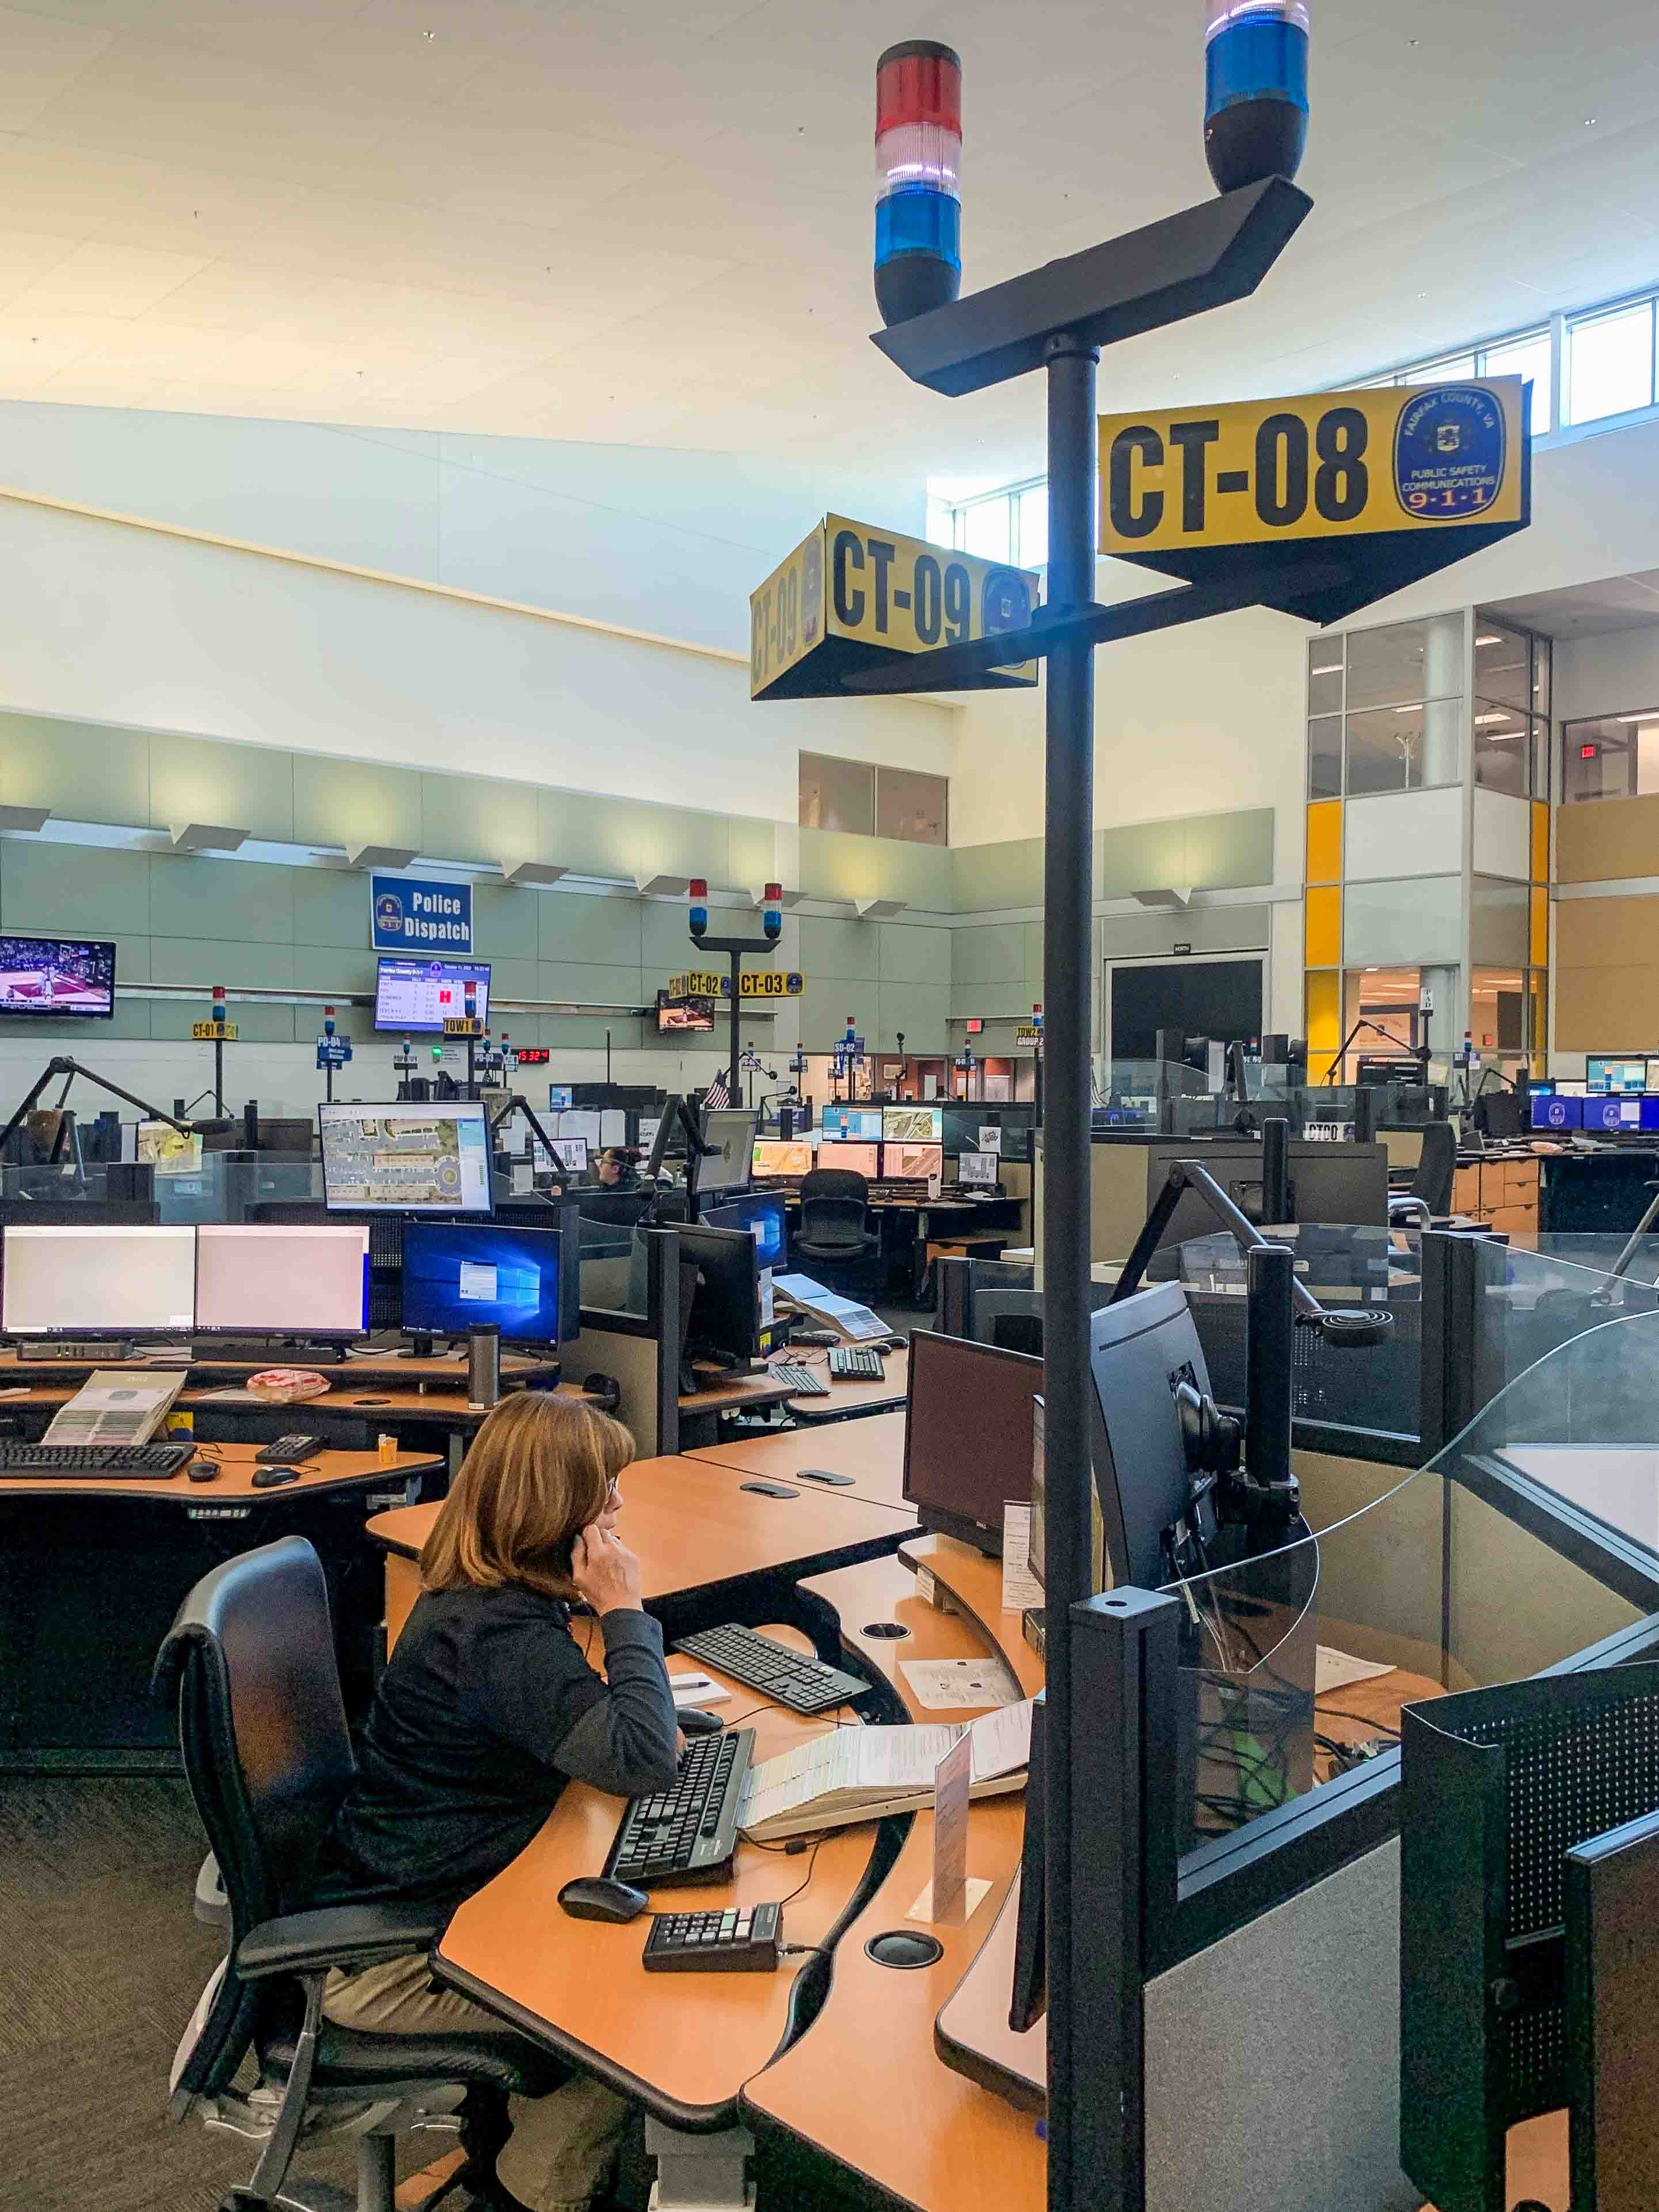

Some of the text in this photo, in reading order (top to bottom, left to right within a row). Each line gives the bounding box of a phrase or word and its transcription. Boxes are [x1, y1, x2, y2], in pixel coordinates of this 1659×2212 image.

[1405, 399, 1437, 436] FAIRFAX
[1483, 412, 1494, 429] VA
[1110, 408, 1368, 538] CT-08
[1411, 465, 1487, 479] PUBLIC SAFETY
[1402, 476, 1496, 491] COMMUNICATIONS
[834, 530, 971, 645] CT-09
[752, 566, 797, 684] CT-09
[413, 892, 461, 915] Police
[405, 917, 470, 941] Dispatch
[691, 973, 718, 994] CT-02
[741, 974, 783, 993] CT-03
[193, 1023, 214, 1036] CT-01
[835, 1043, 855, 1052] SD-02
[1017, 1037, 1044, 1046] GROUP 2
